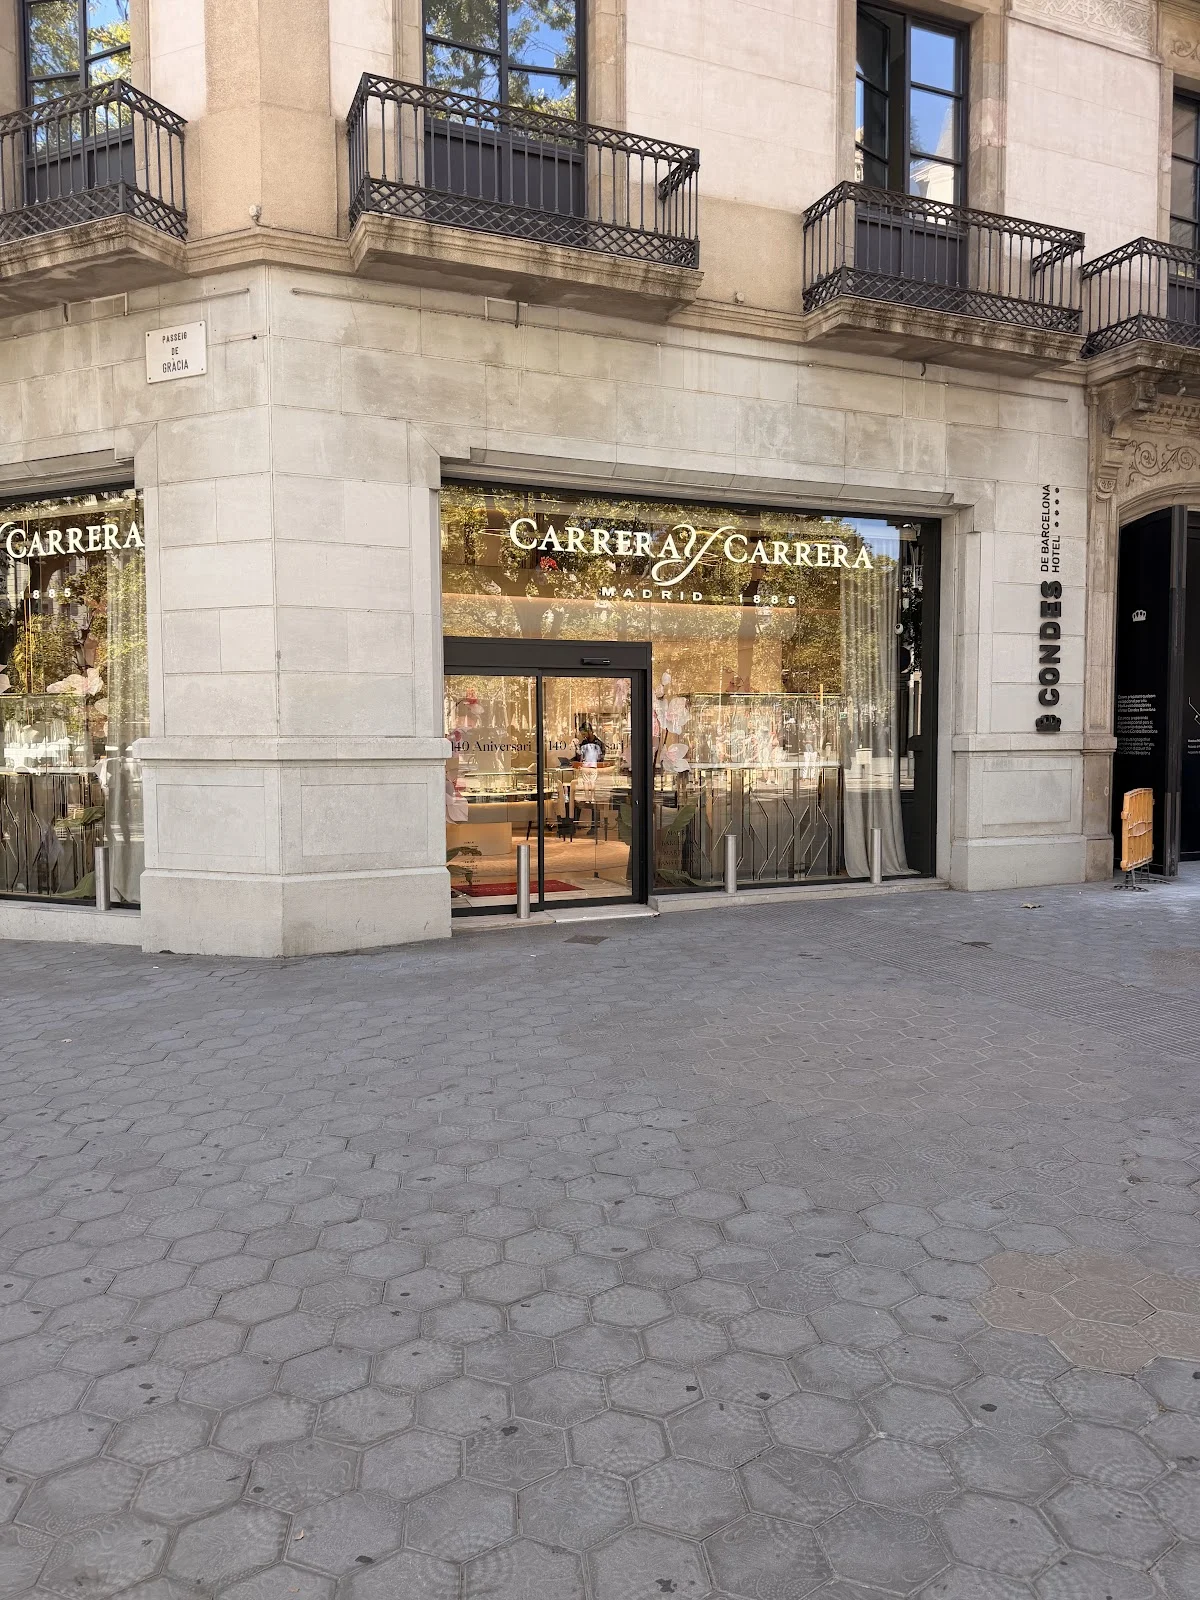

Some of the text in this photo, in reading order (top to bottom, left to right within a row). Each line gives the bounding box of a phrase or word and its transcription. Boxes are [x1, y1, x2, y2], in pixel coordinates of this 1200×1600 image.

[162, 331, 187, 344] PASSEIG
[171, 346, 179, 356] DE
[162, 358, 189, 373] GRÀCIA
[1041, 484, 1051, 573] DE BARCELONA
[6, 521, 145, 559] CARRERA
[509, 517, 874, 587] CARRERA Y CARRERA
[1052, 535, 1061, 573] HOTEL
[20, 587, 71, 600] 1885
[601, 586, 797, 606] MADRID 1885
[1038, 580, 1063, 707] CONDES
[474, 740, 532, 752] Aniversari
[549, 740, 567, 751] 140
